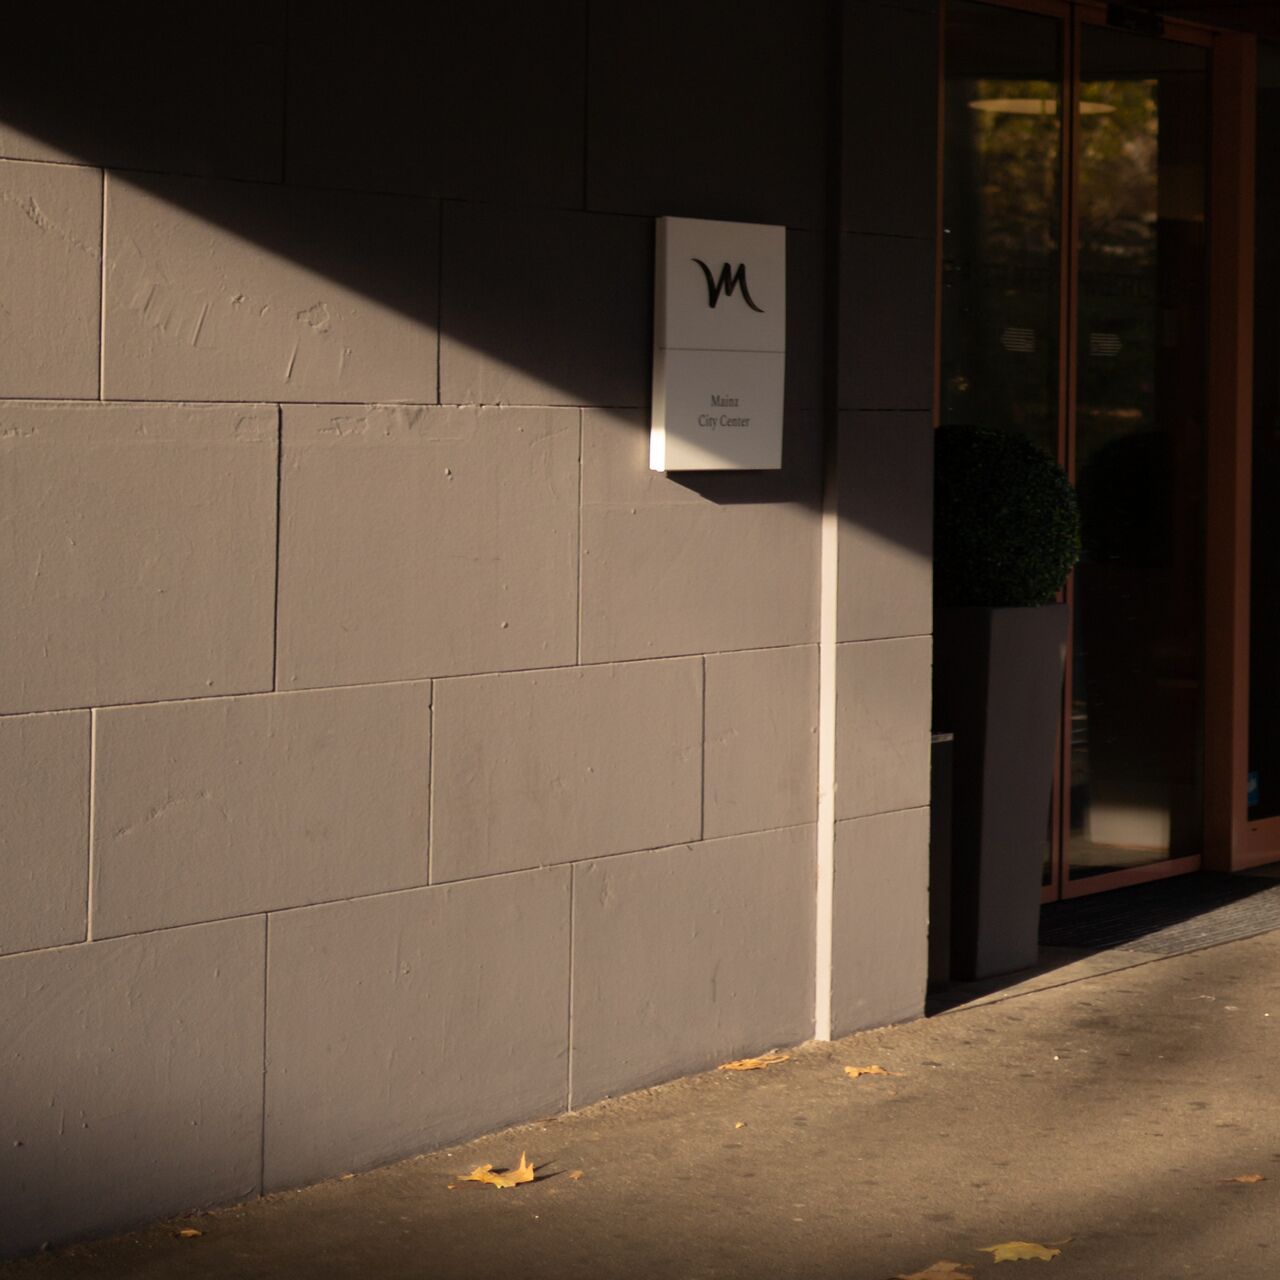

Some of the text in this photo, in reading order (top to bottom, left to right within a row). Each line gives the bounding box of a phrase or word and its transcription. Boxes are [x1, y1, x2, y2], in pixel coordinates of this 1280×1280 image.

[711, 394, 739, 408] Mainz
[698, 414, 751, 431] City Center
